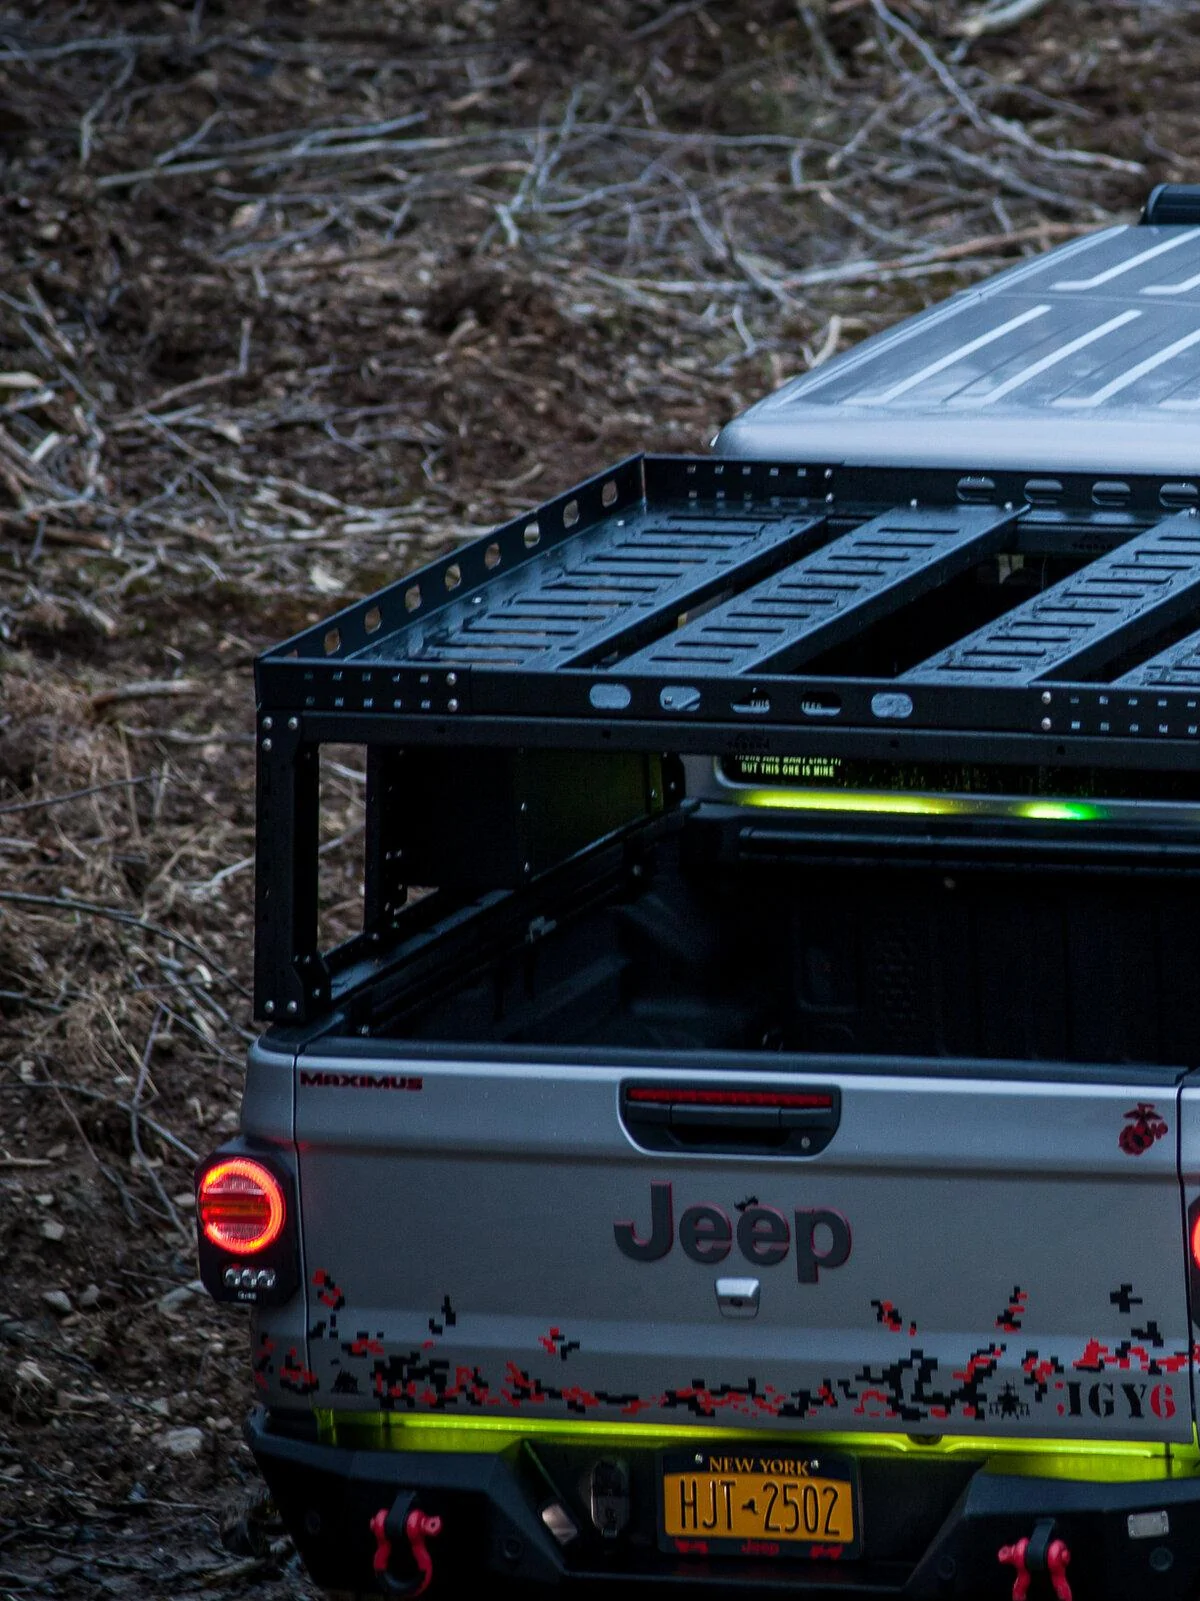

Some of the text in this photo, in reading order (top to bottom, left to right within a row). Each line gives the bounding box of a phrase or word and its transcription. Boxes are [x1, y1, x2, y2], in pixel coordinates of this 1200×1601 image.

[741, 762, 834, 777] BUT THIS ONE IS MINE
[300, 1070, 424, 1091] MAXIMUS
[613, 1180, 852, 1283] Jeep
[709, 1455, 809, 1476] NEW YORK
[680, 1478, 840, 1536] HJT 2502
